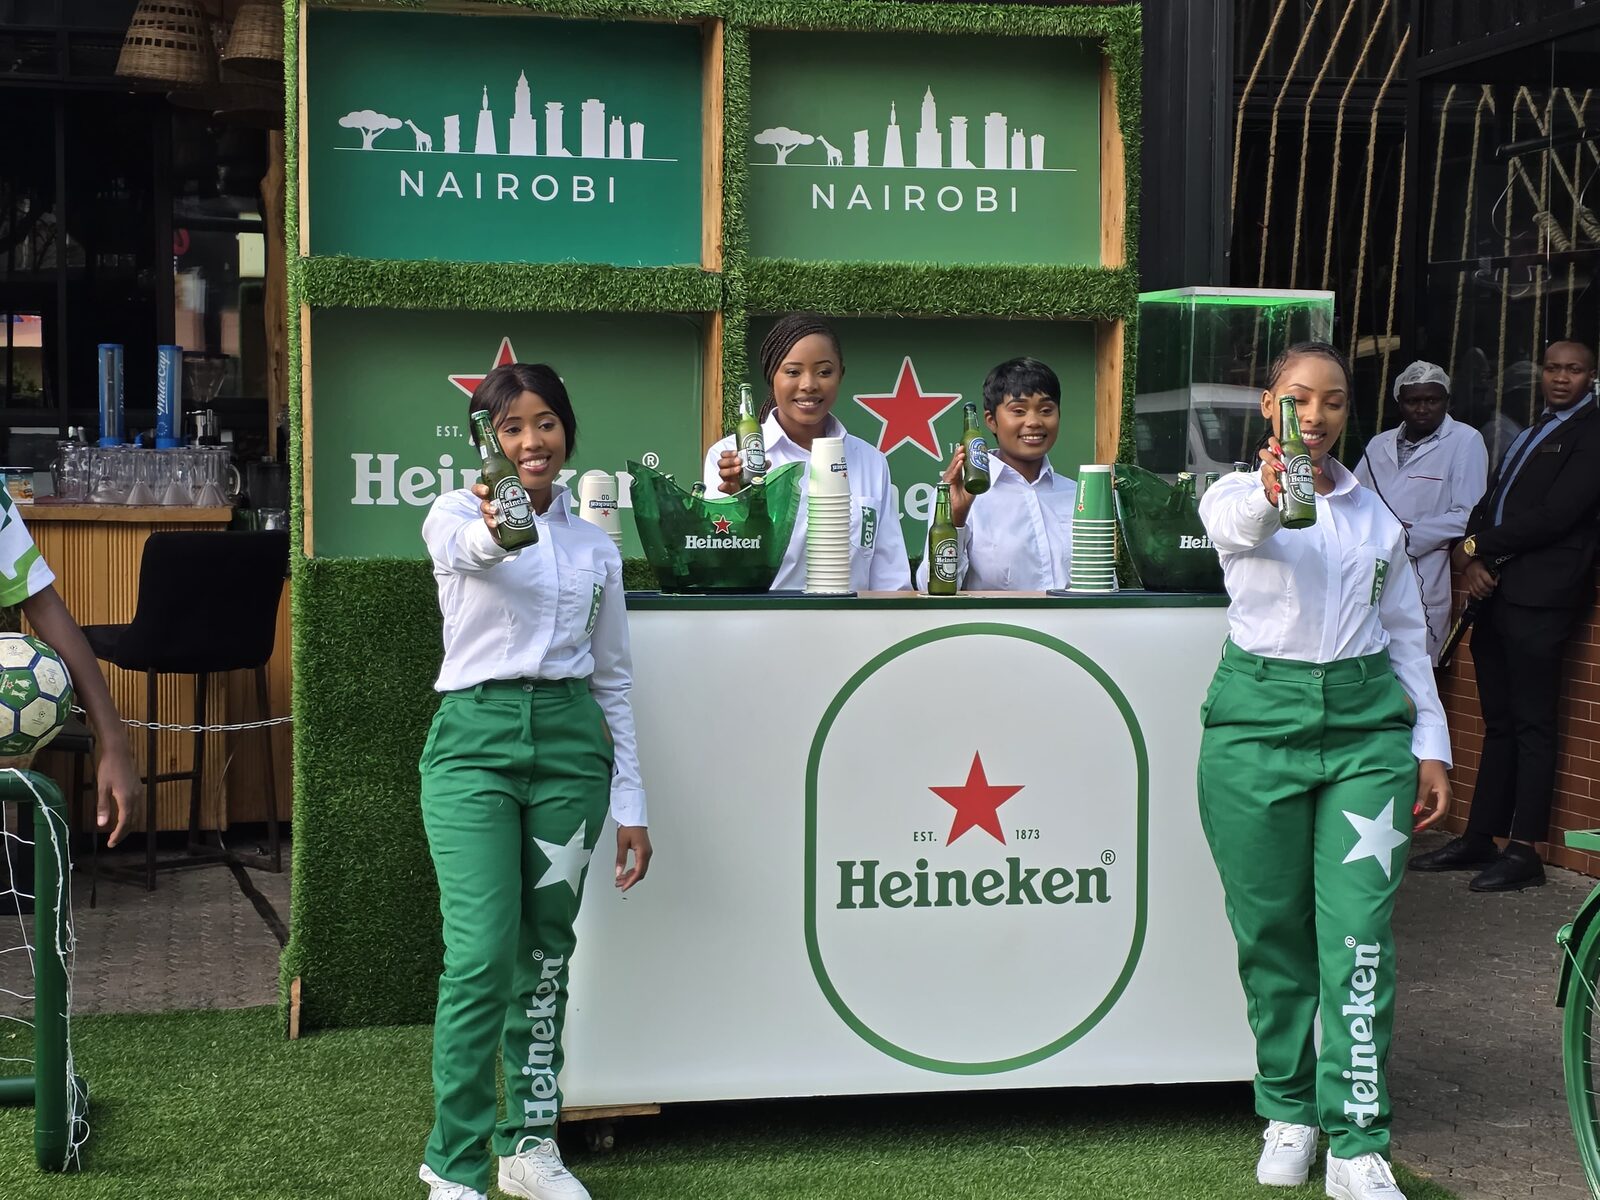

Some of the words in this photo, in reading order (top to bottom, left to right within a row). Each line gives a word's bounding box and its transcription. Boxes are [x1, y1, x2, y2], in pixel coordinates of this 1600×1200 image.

[399, 169, 616, 204] NAIROBI
[812, 183, 1018, 213] NAIROBI
[436, 425, 463, 438] EST.
[684, 534, 760, 549] Heineken
[913, 831, 938, 843] EST.
[1015, 828, 1041, 841] 1873
[836, 856, 1112, 909] Heineken
[521, 953, 565, 1129] Heineken
[1342, 941, 1381, 1130] Heineken
